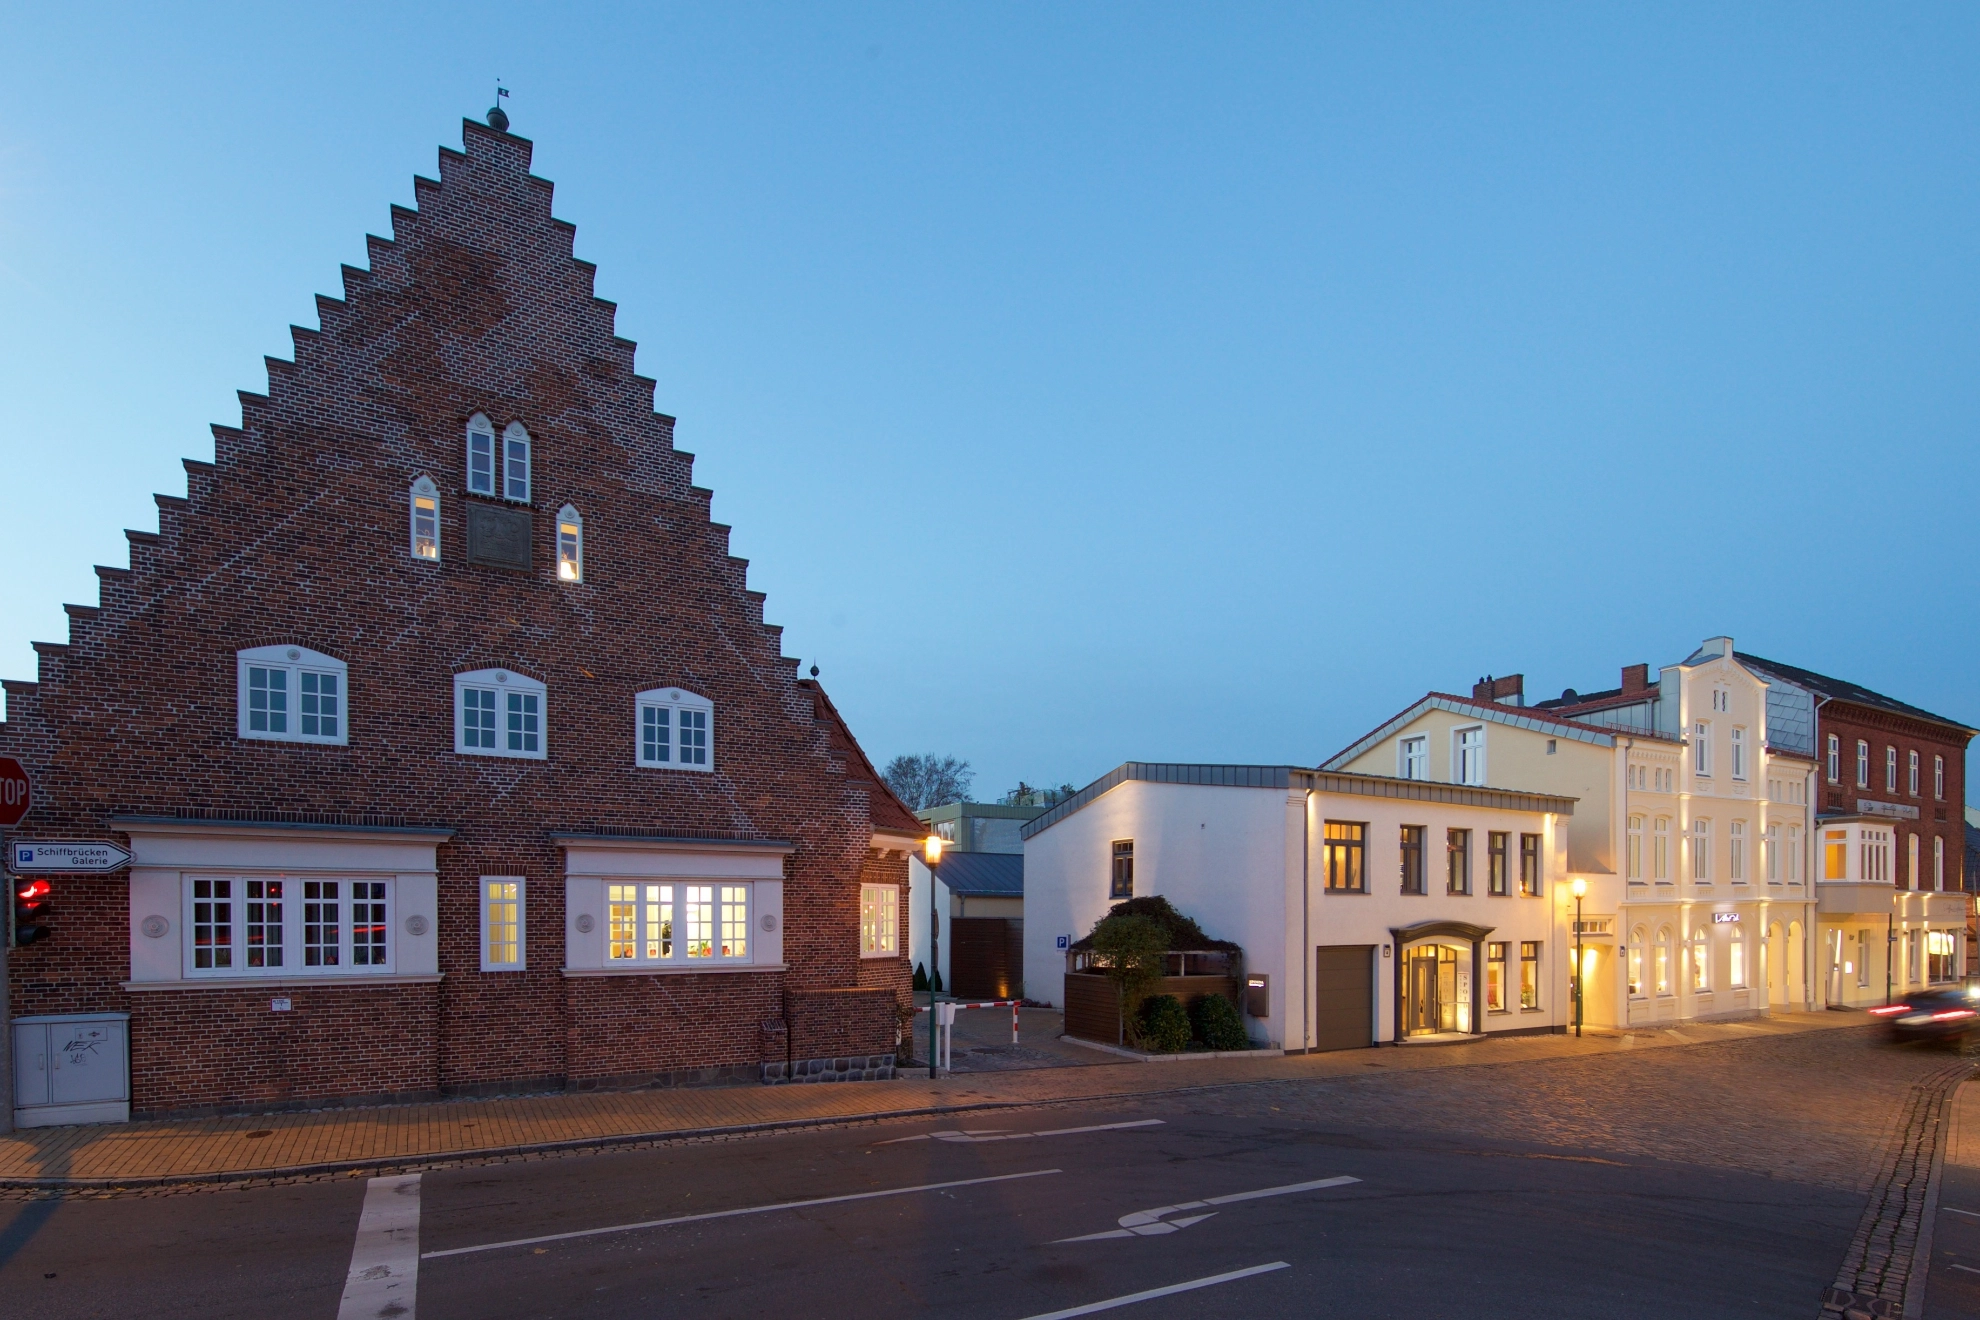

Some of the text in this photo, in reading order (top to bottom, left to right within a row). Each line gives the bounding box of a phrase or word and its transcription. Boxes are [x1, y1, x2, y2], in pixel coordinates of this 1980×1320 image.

[22, 851, 30, 860] P
[37, 847, 108, 857] Schiffbrücken
[72, 857, 108, 865] Galerie
[1059, 938, 1065, 947] P
